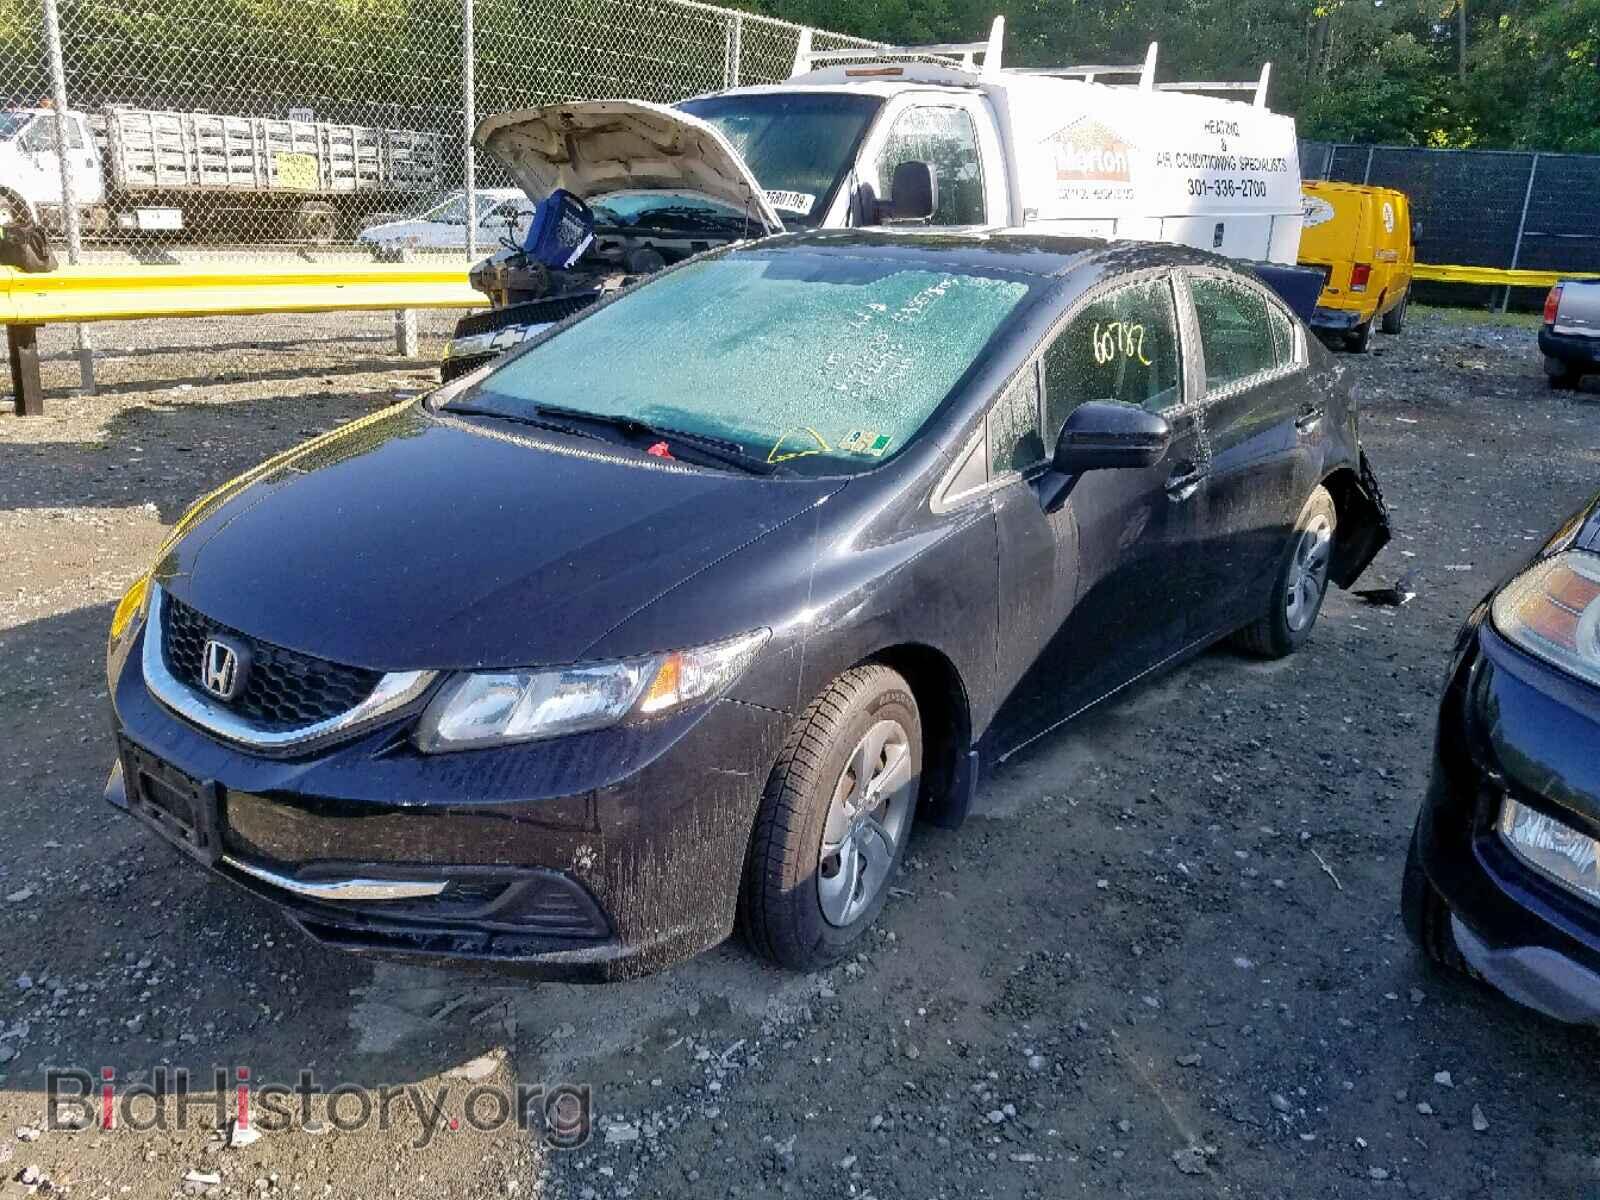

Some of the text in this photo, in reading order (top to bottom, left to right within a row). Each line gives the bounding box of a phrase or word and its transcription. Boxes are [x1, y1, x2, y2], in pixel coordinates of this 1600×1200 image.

[1204, 119, 1240, 137] HEATING
[1156, 151, 1288, 173] AIR CONDITIONING SPECIALISTS
[1187, 178, 1267, 198] 301-336-2700
